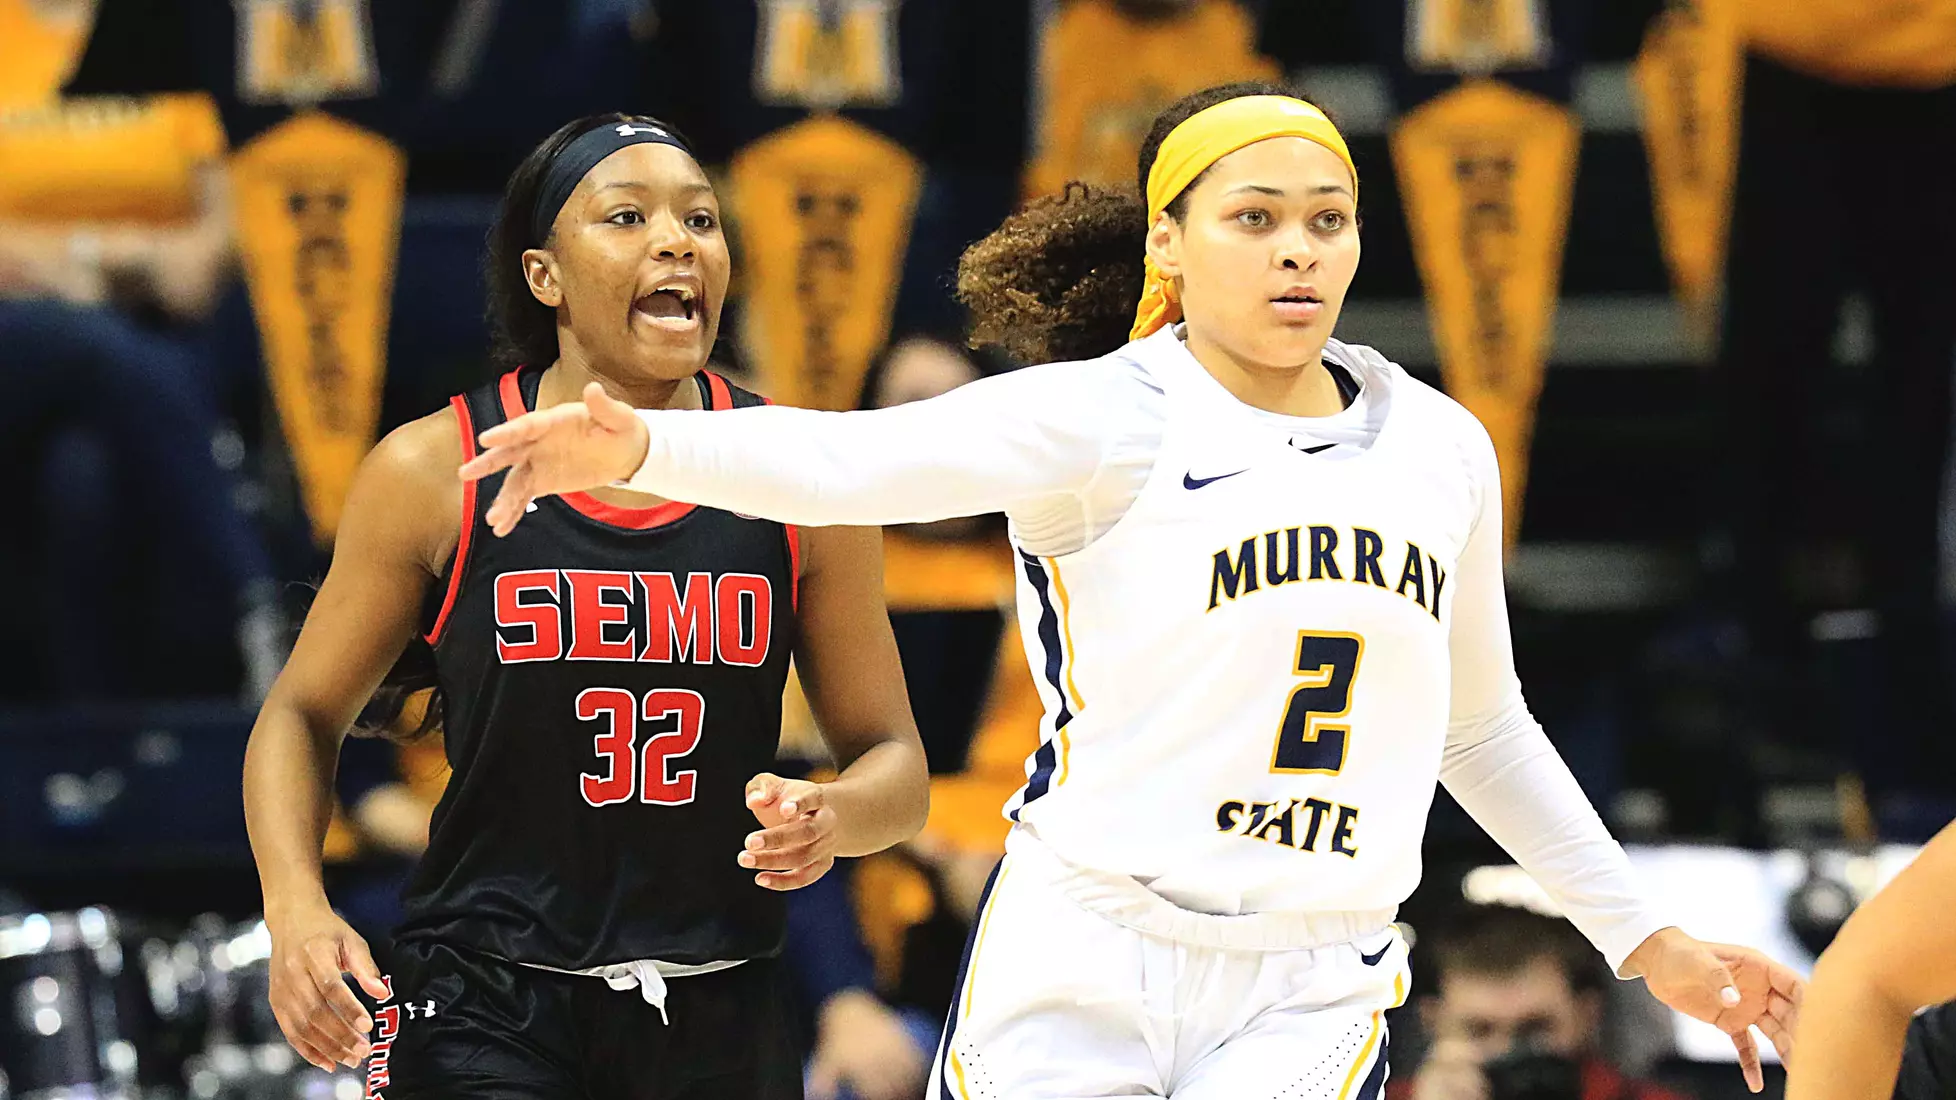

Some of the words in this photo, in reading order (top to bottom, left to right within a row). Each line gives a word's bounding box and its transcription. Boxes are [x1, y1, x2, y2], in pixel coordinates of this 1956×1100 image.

[494, 569, 772, 667] SEMO
[1205, 525, 1446, 623] MURRAY
[575, 687, 705, 807] 32
[1269, 629, 1365, 776] 2
